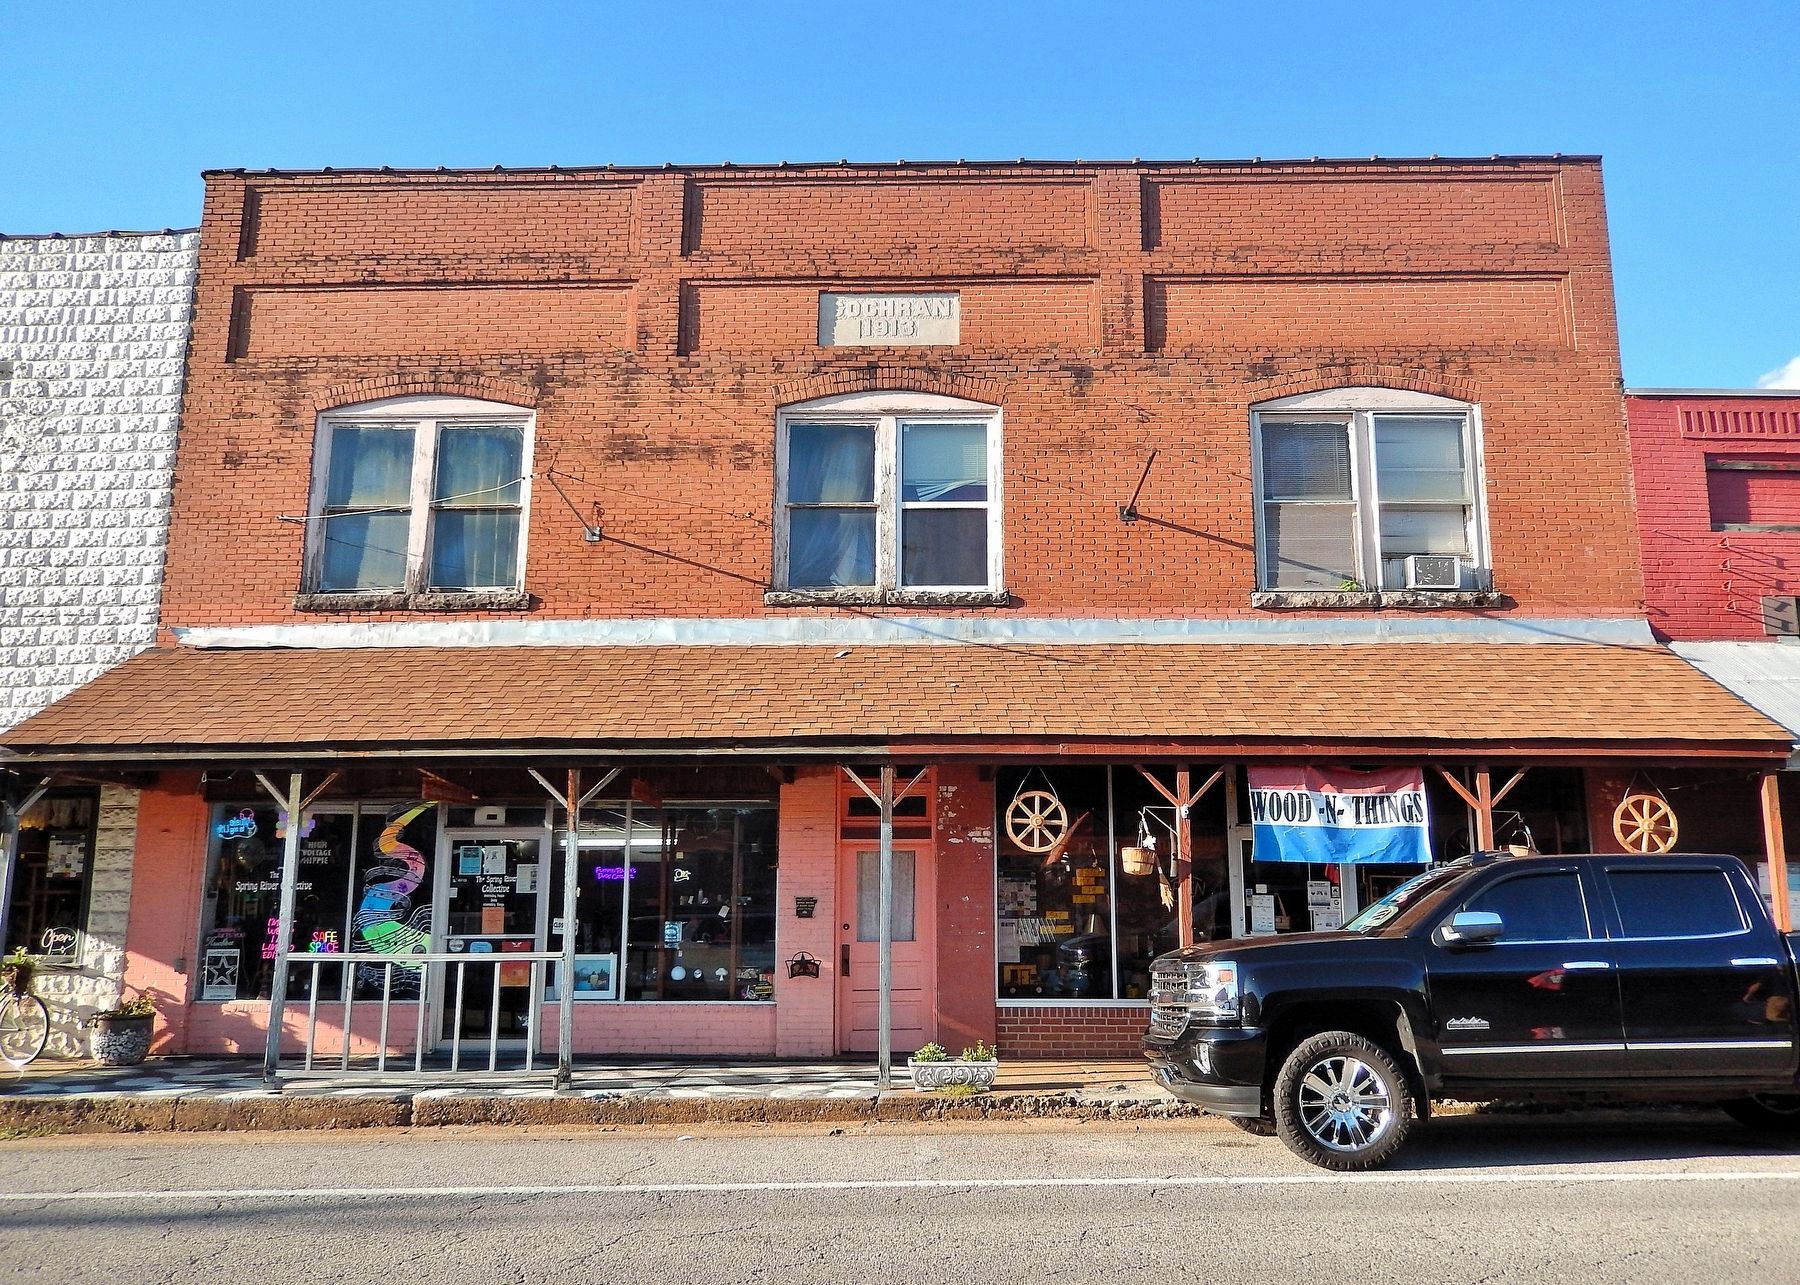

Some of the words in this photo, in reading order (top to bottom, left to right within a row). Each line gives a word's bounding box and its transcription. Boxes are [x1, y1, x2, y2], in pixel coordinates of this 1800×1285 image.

[860, 319, 916, 337] 1913
[1250, 791, 1312, 822] WOOD
[1352, 792, 1424, 825] THINGS
[235, 881, 258, 892] Spring
[260, 880, 280, 891] River
[41, 928, 75, 955] Open
[312, 930, 338, 943] SAFE
[309, 942, 339, 953] SPACE
